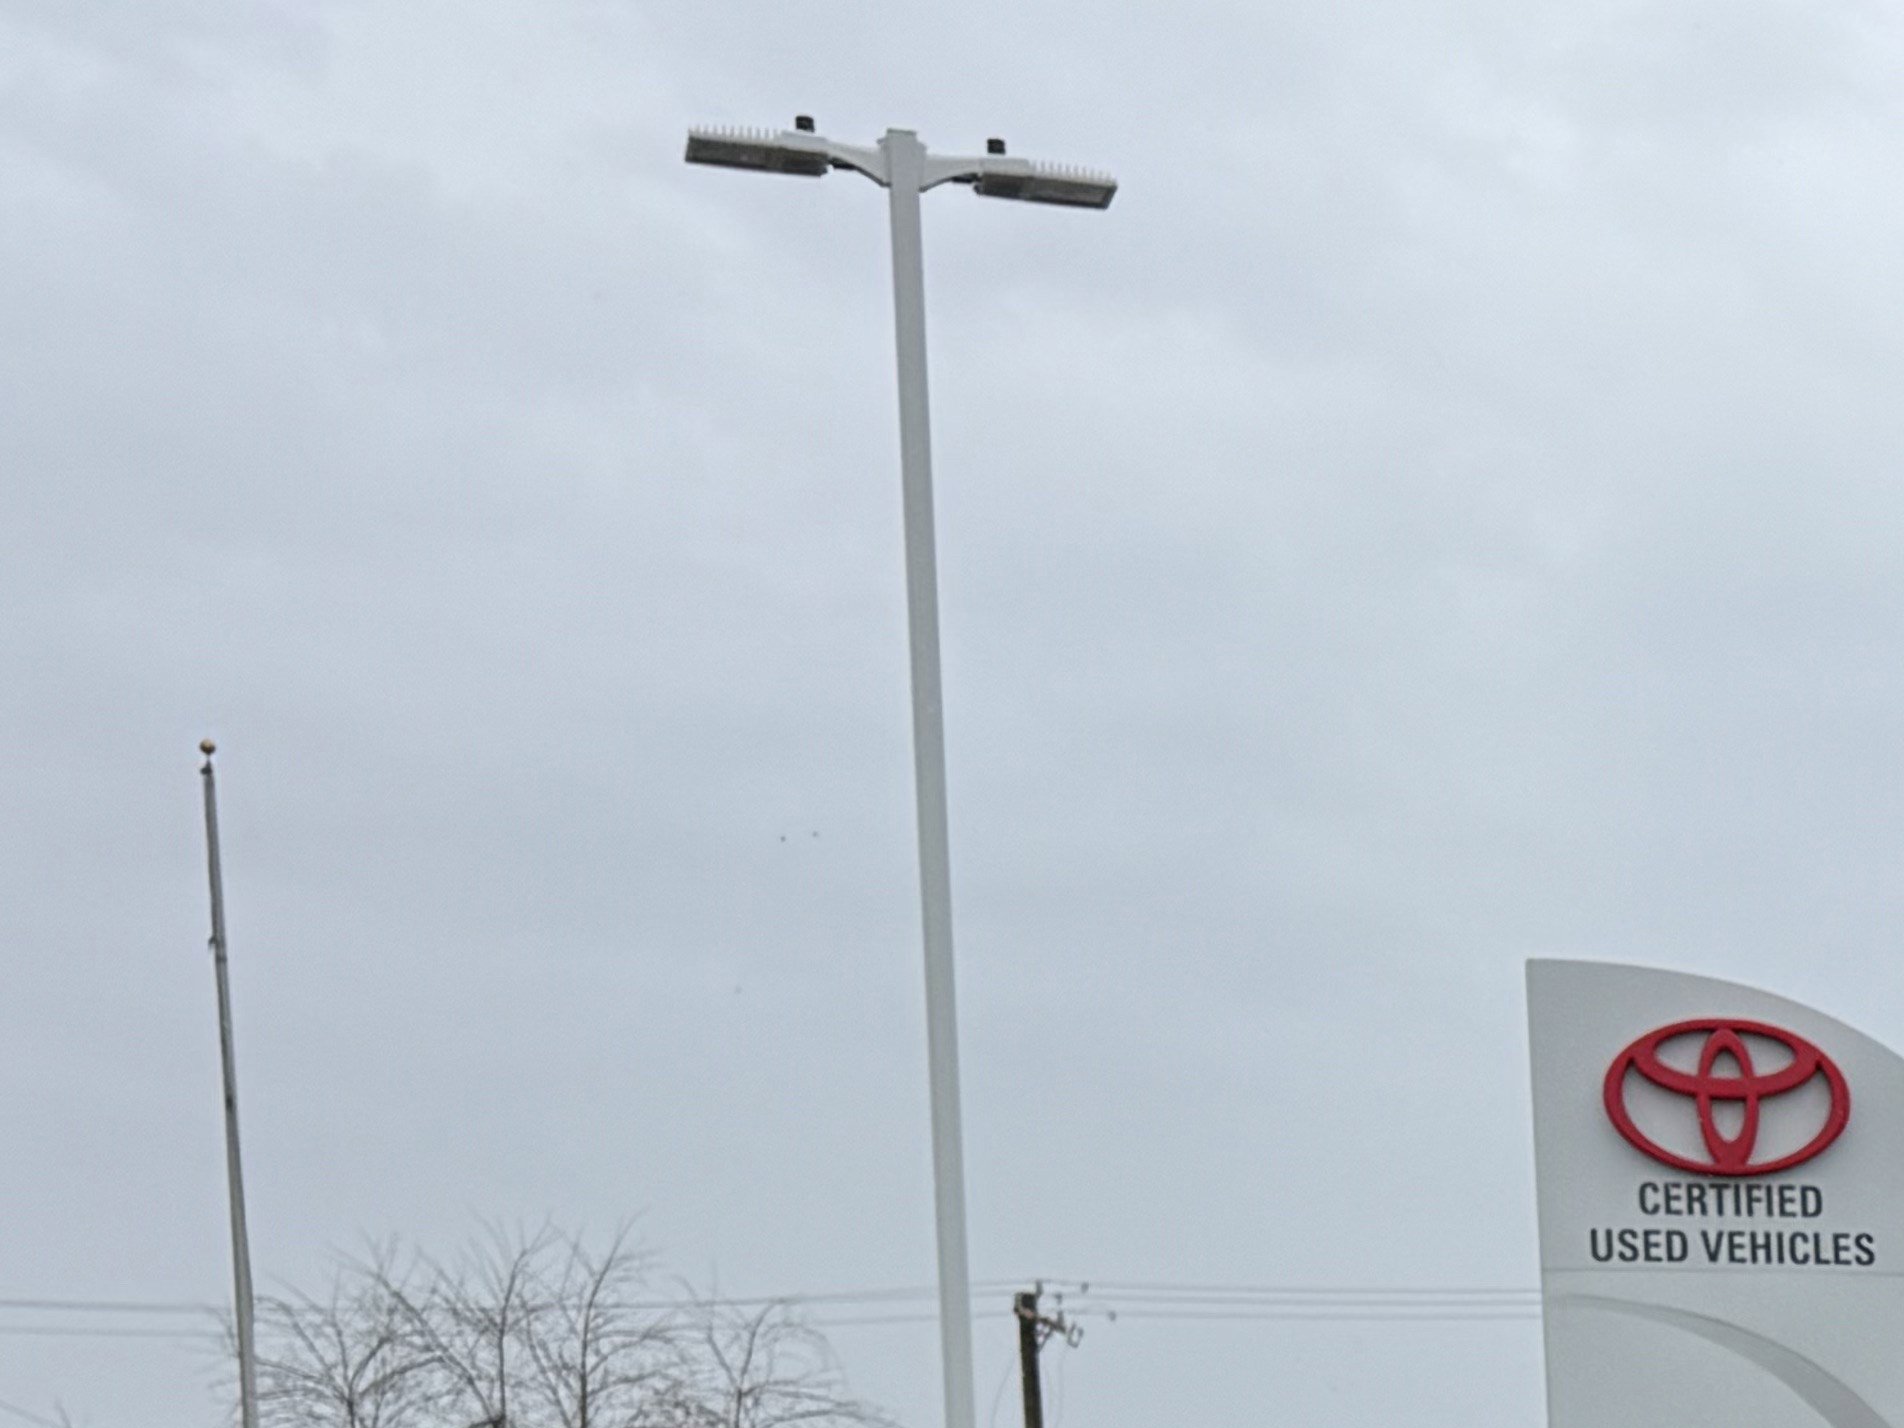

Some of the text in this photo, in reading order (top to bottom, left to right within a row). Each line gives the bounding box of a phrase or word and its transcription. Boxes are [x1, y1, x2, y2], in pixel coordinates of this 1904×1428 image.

[1638, 1181, 1824, 1218] CERTIFIED
[1590, 1228, 1876, 1266] USED VEHICLES
